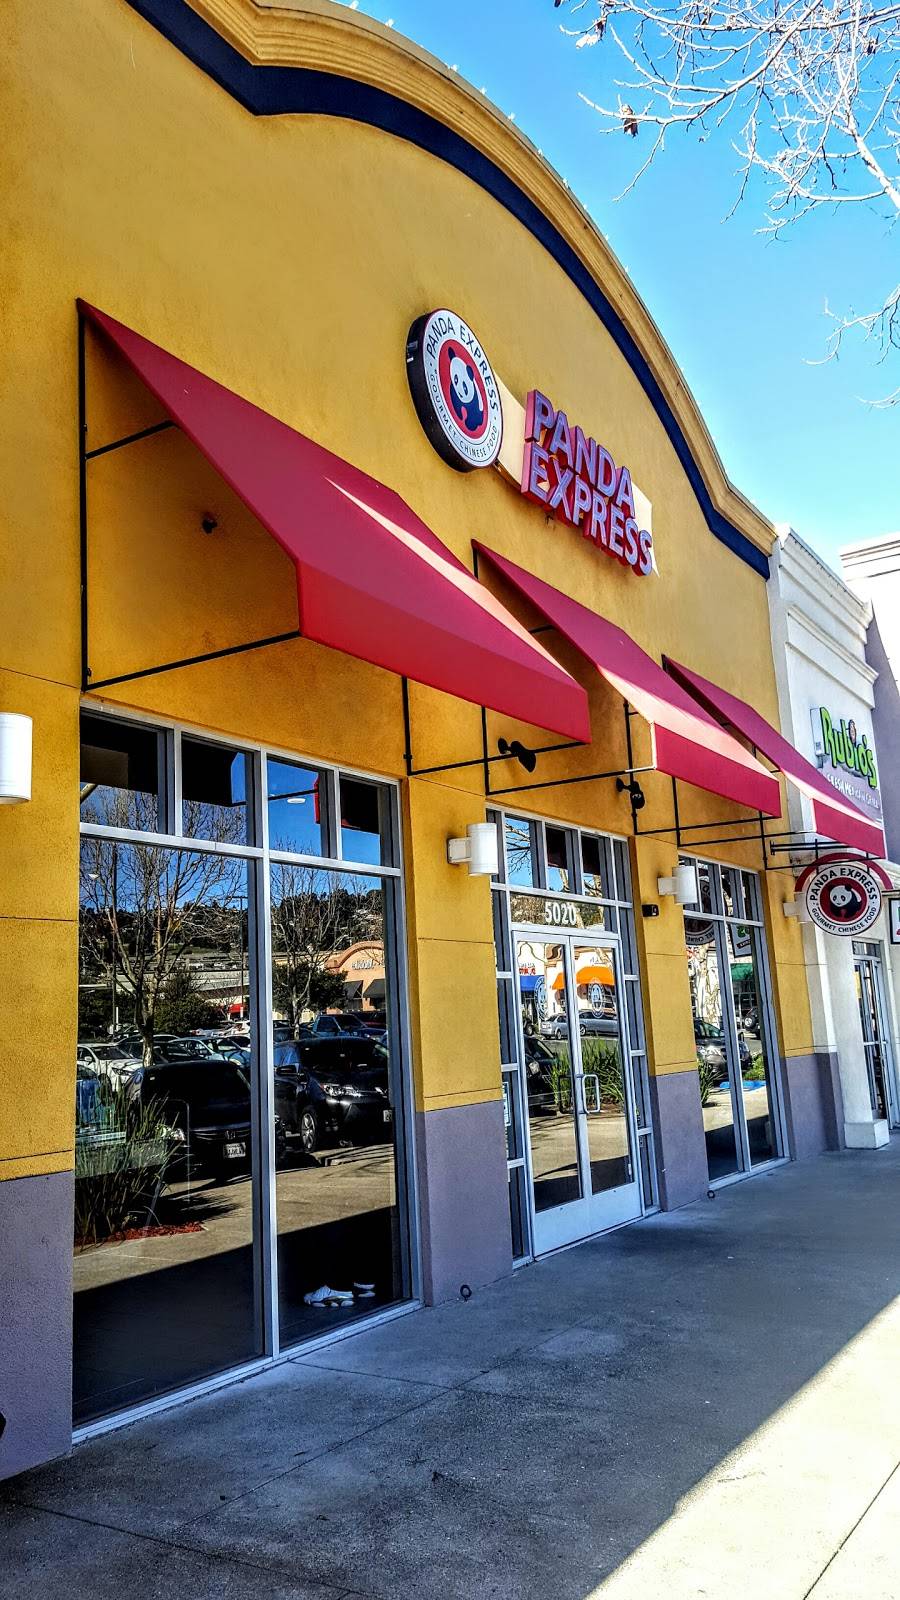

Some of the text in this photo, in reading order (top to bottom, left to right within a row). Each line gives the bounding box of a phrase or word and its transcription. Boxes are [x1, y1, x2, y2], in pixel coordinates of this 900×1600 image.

[426, 317, 499, 413] PANDA EXPRESS
[429, 372, 498, 458] GOURMET CHINESE FOOD
[526, 389, 636, 519] PANDA
[521, 441, 653, 576] EXPRESS
[544, 901, 577, 926] 5020
[809, 867, 878, 901] PANDA EXPRESS
[811, 907, 877, 933] GOURMET CHINESE FOOD
